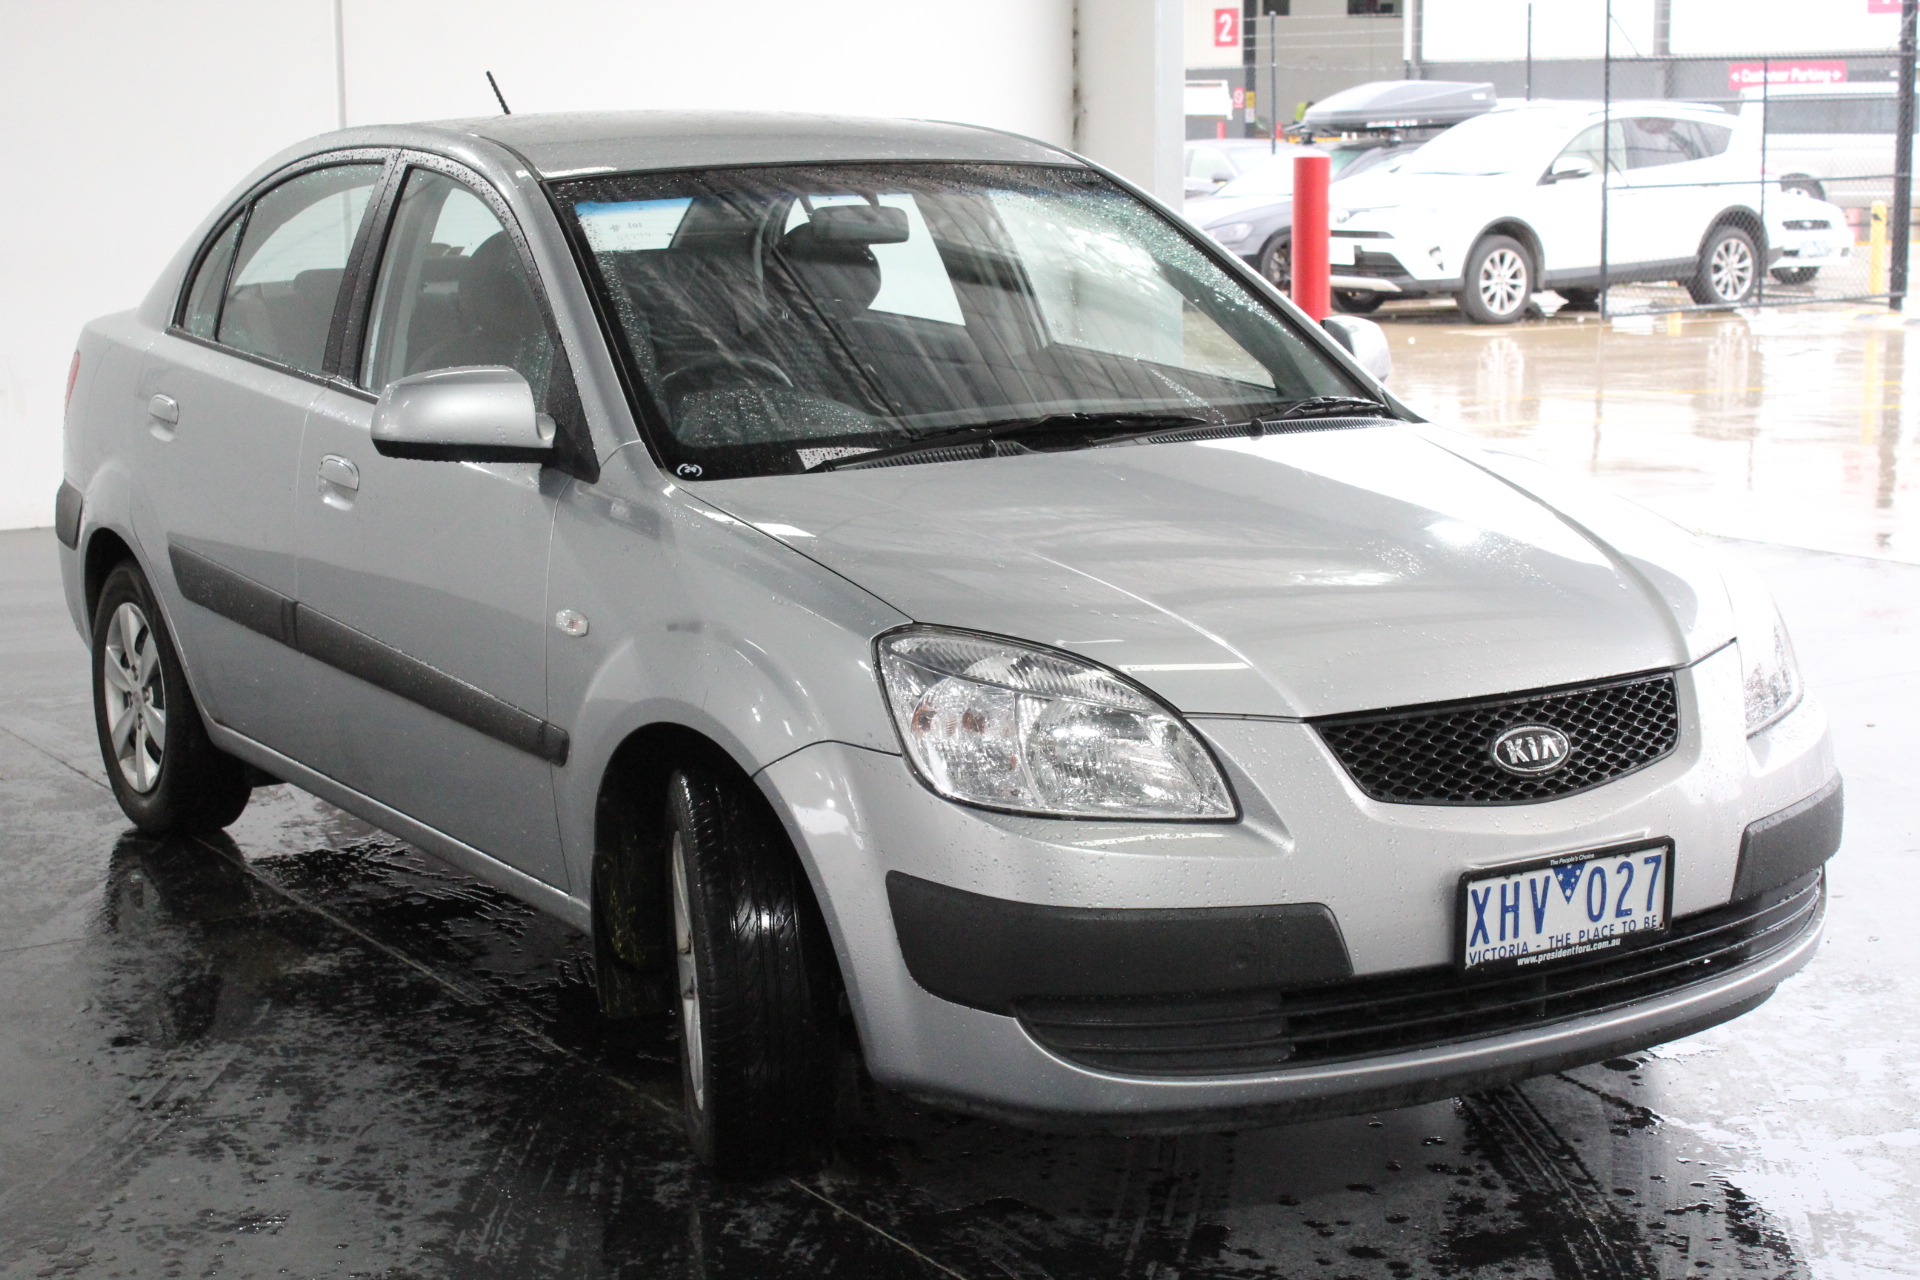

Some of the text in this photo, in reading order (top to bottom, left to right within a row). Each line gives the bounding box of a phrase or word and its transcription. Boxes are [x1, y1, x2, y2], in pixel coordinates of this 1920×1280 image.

[1218, 12, 1233, 42] 2
[1791, 67, 1832, 84] Parking
[1504, 734, 1560, 765] KIA
[1559, 856, 1579, 864] People's
[1579, 853, 1595, 861] Choice
[1469, 855, 1662, 947] XHV 027
[1469, 941, 1529, 965] VICTORIA
[1549, 931, 1571, 949] THE
[1578, 925, 1615, 943] PLACE
[1621, 919, 1637, 933] TO
[1643, 914, 1657, 929] BE
